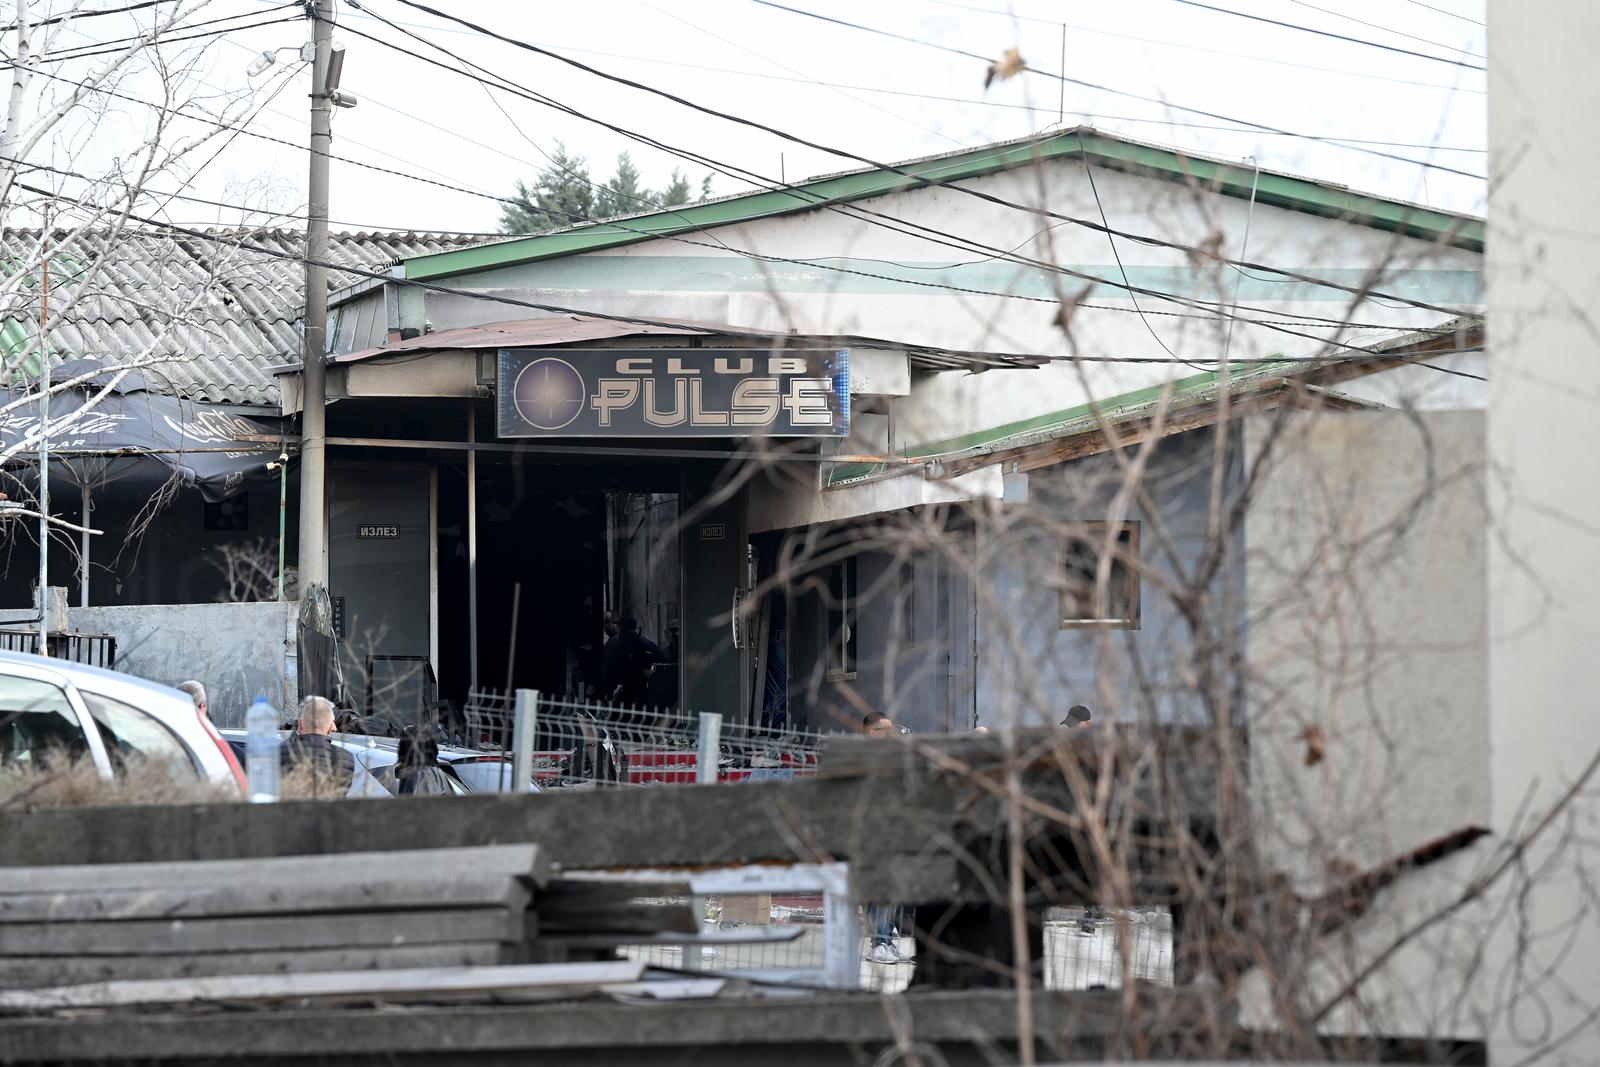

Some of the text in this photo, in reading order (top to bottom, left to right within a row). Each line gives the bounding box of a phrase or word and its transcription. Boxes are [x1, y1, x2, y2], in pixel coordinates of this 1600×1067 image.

[616, 358, 808, 374] CLUB
[590, 377, 833, 428] PULSE
[360, 526, 398, 537] ИЗЛЕЗ
[702, 526, 723, 537] ИЗЛЕЗ
